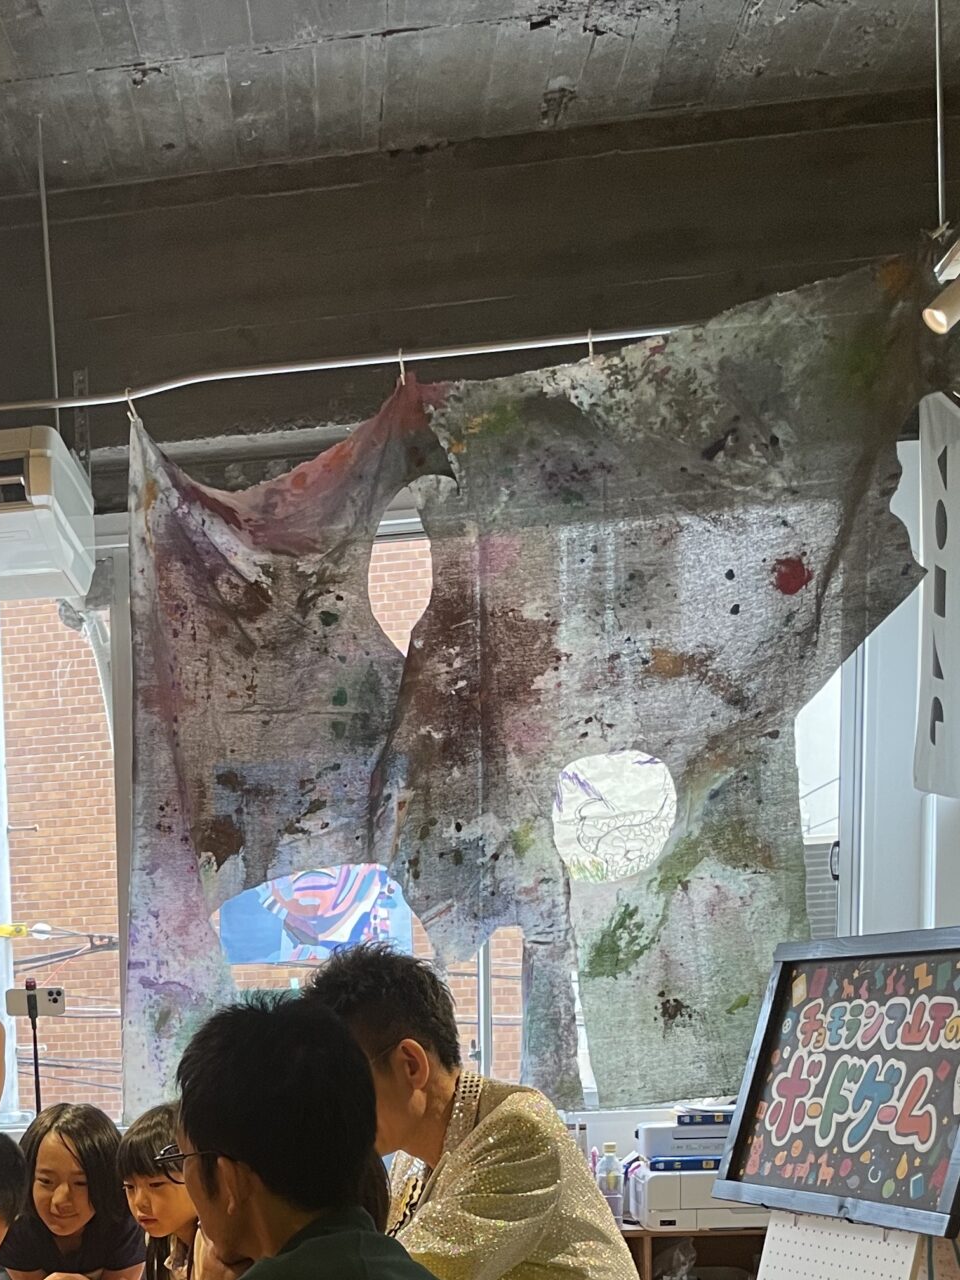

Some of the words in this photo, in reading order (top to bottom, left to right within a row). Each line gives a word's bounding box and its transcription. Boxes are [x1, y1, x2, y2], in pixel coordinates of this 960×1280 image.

[765, 1052, 937, 1153] ボードゲーム
